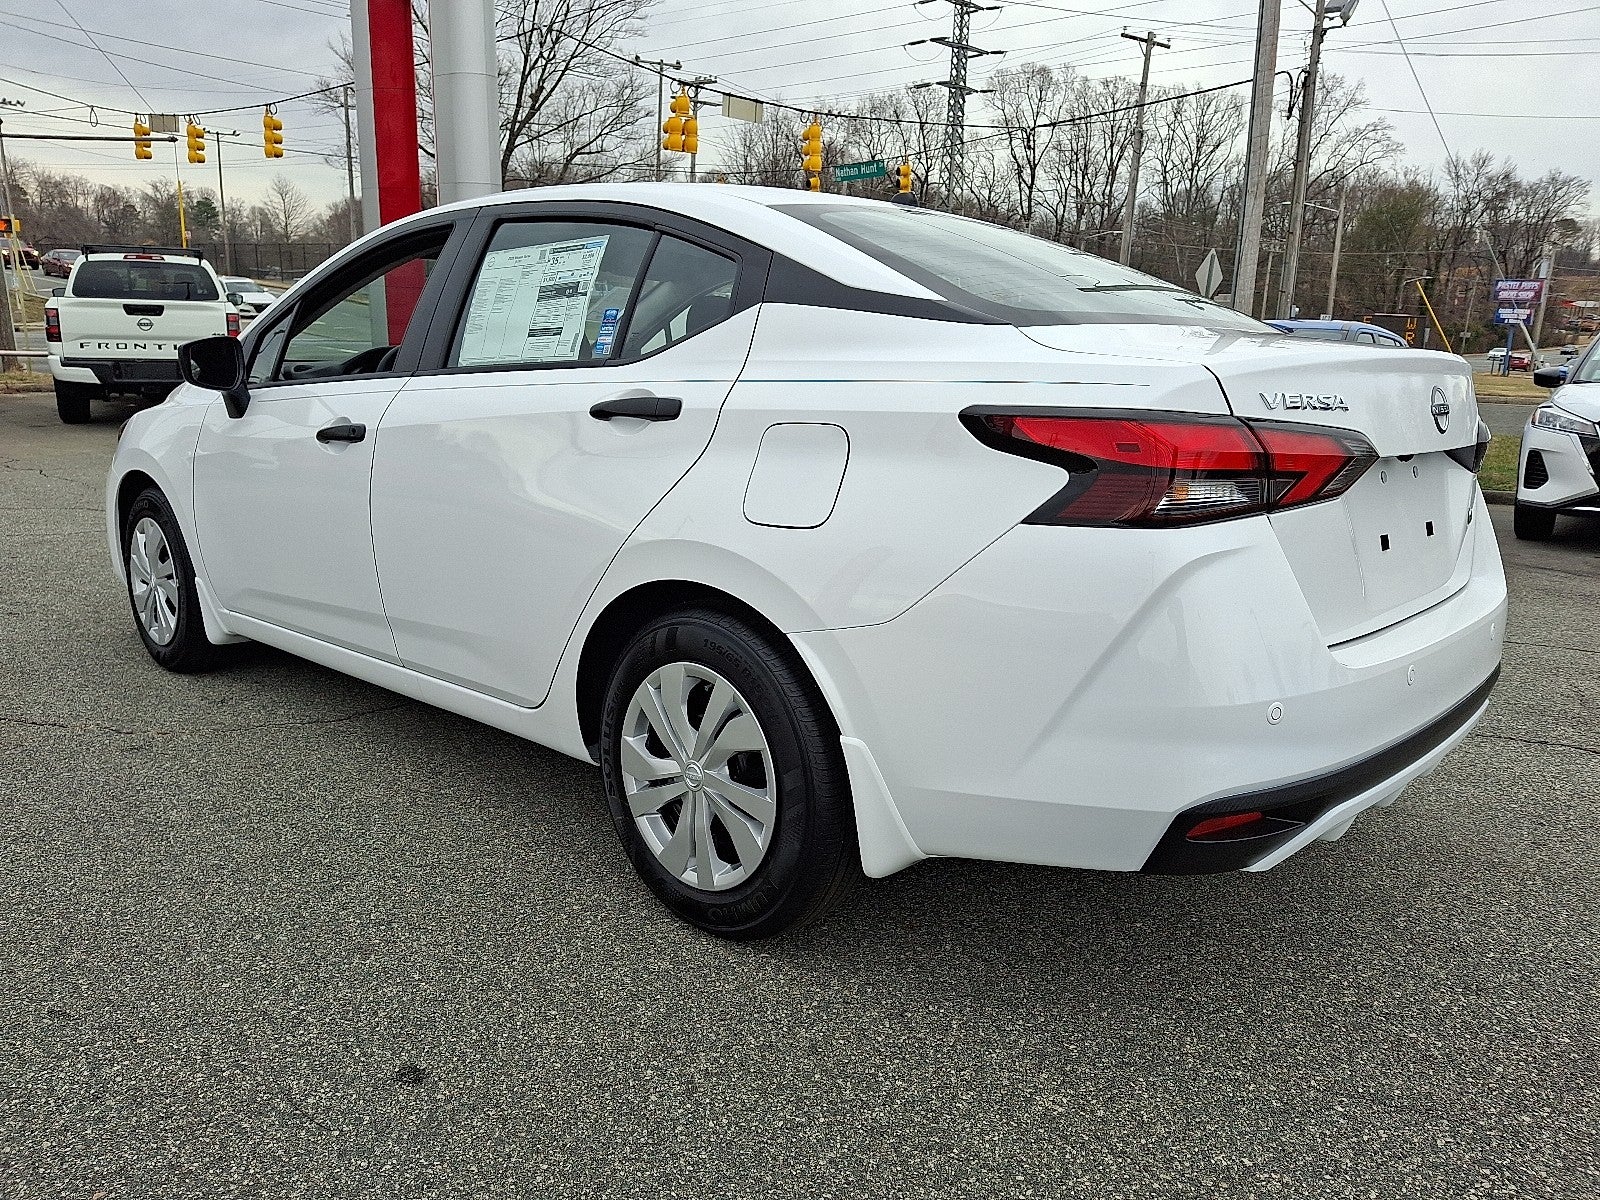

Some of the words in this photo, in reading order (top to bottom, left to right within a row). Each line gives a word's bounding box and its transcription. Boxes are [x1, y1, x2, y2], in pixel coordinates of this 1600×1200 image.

[835, 166, 859, 177] Nathan
[860, 163, 878, 174] Hunt
[1520, 281, 1541, 290] PUFFS
[79, 342, 179, 351] FRONTI
[1259, 392, 1350, 412] VERSA
[1433, 404, 1450, 414] NISSA
[703, 638, 741, 667] 195/65
[601, 705, 617, 800] SOLUS
